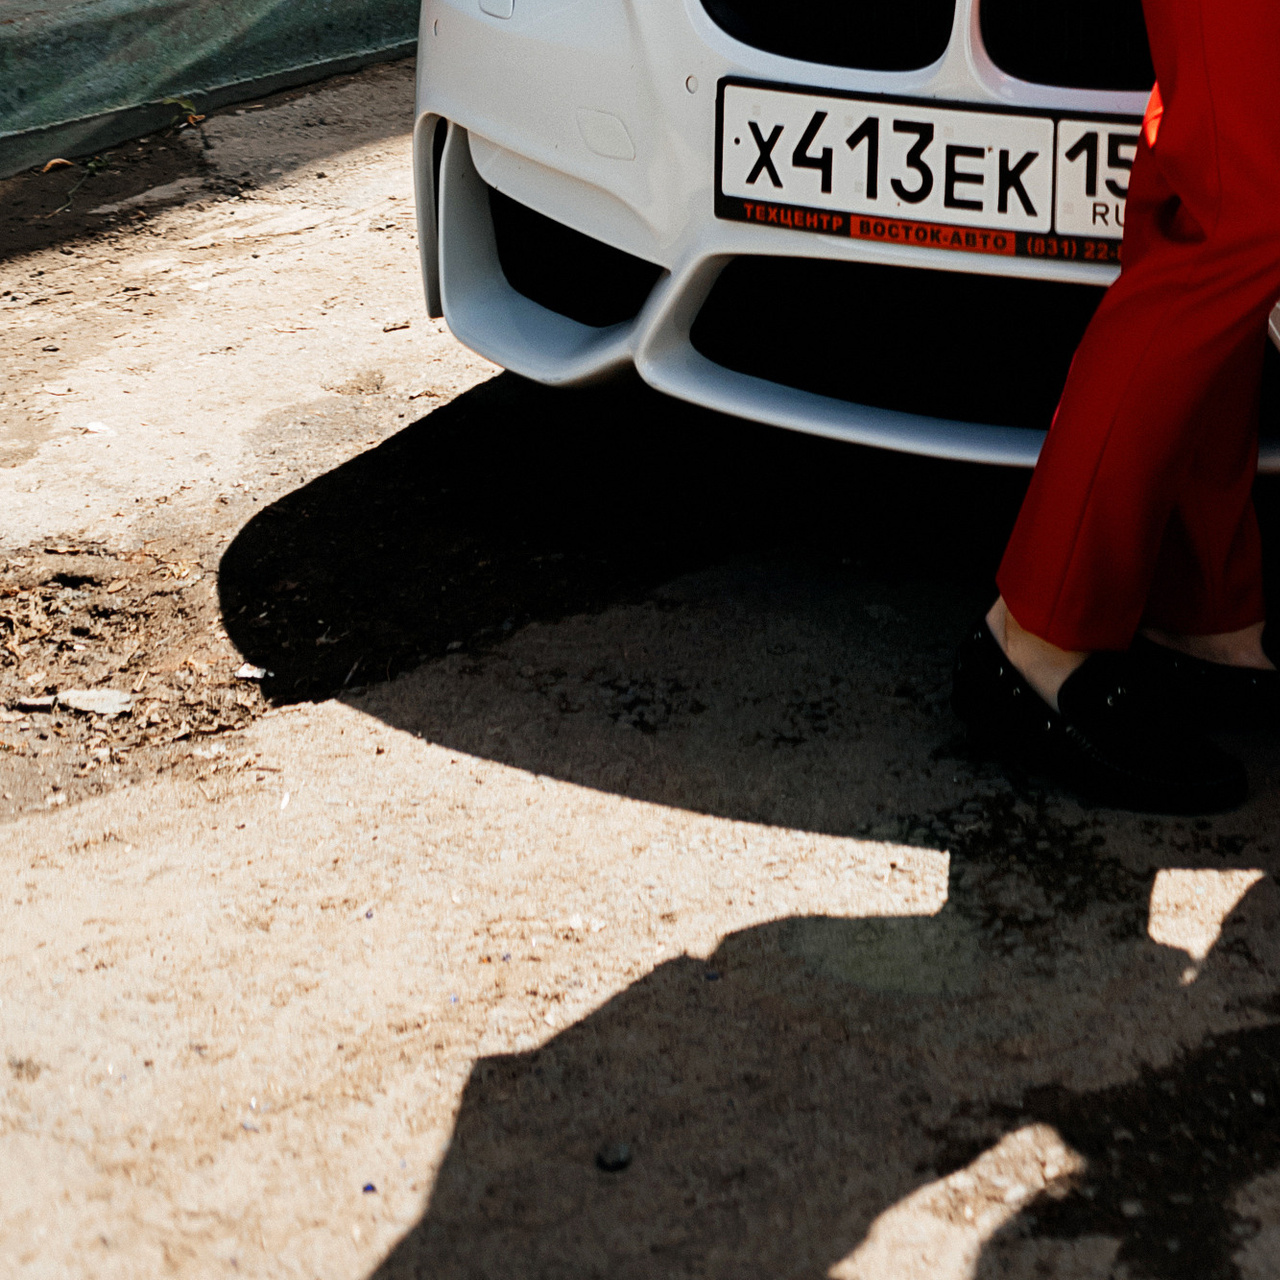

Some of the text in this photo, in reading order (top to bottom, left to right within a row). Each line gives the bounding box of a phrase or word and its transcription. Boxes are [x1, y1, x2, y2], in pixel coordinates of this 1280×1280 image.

[745, 111, 1039, 218] Х413ЕК
[743, 203, 844, 232] ТЕХЦЕНТР
[859, 221, 1008, 251] ВОСТОК-АВТО
